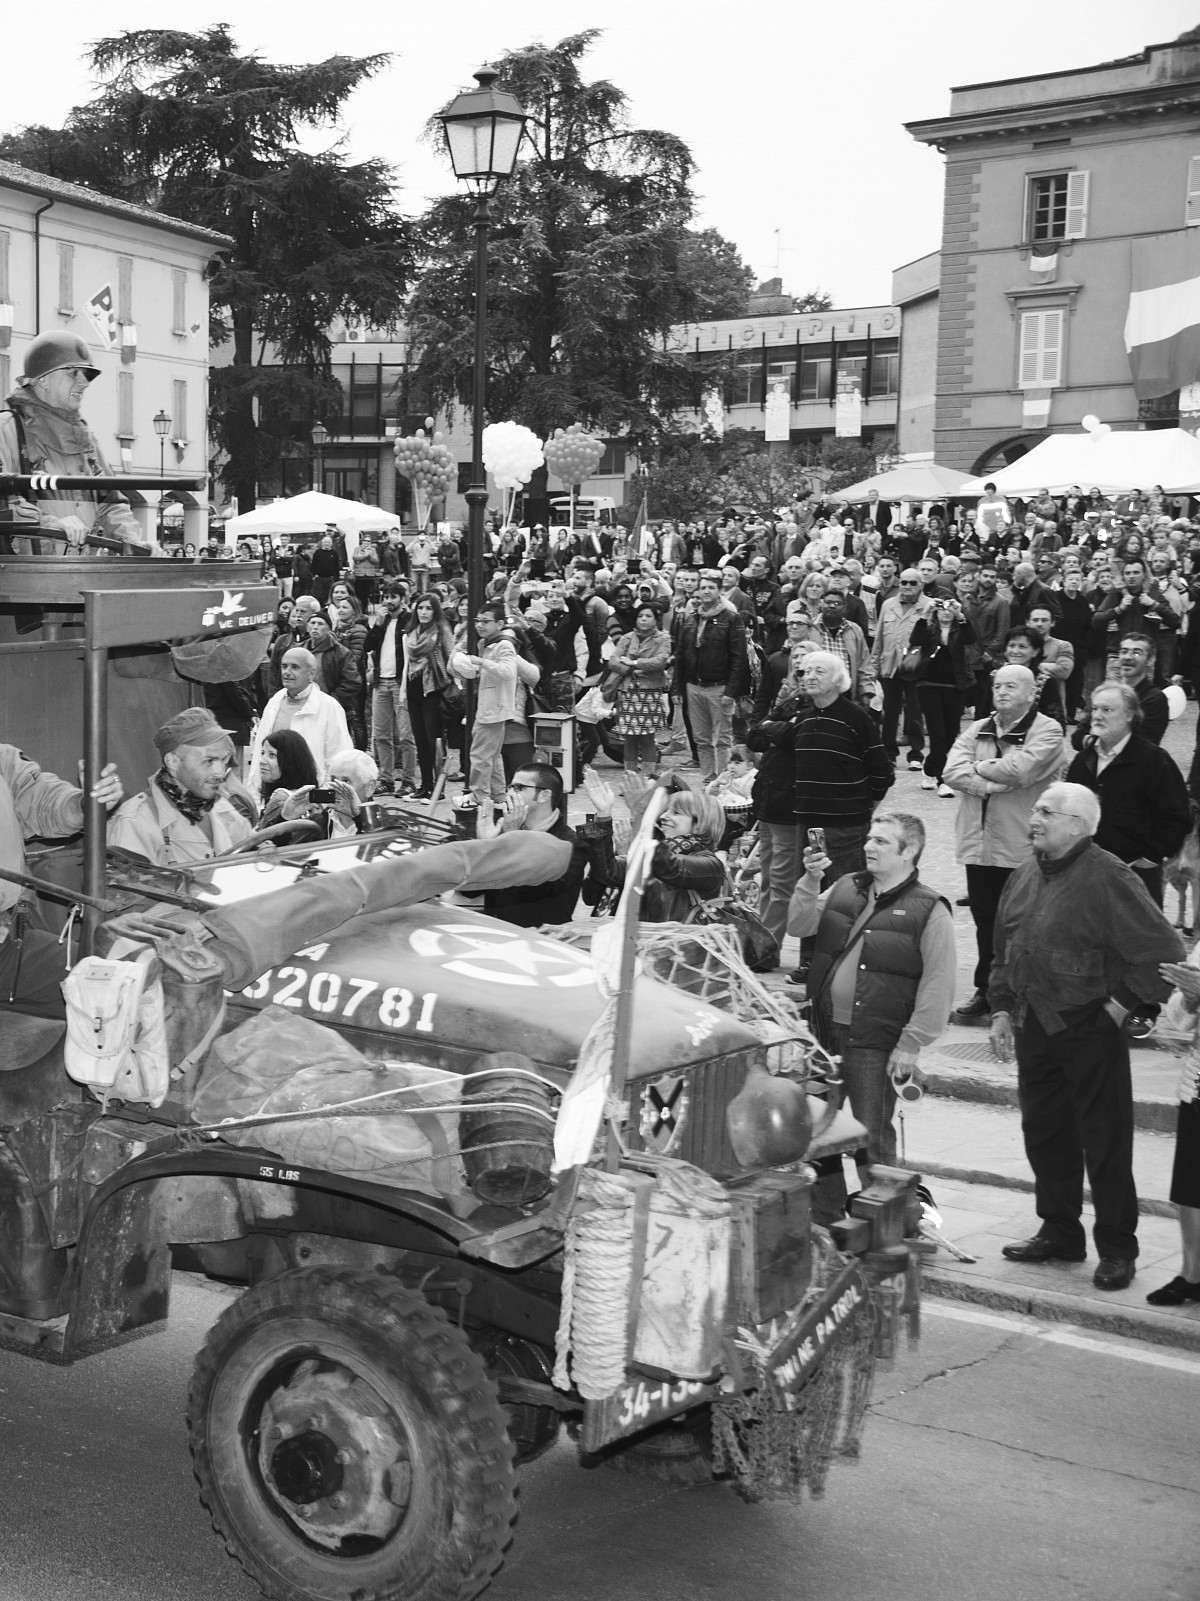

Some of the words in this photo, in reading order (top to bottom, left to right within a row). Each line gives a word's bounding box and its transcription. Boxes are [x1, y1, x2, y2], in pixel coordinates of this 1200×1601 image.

[218, 619, 234, 629] WE
[238, 611, 274, 627] DELIVER
[278, 1169, 301, 1181] LBS
